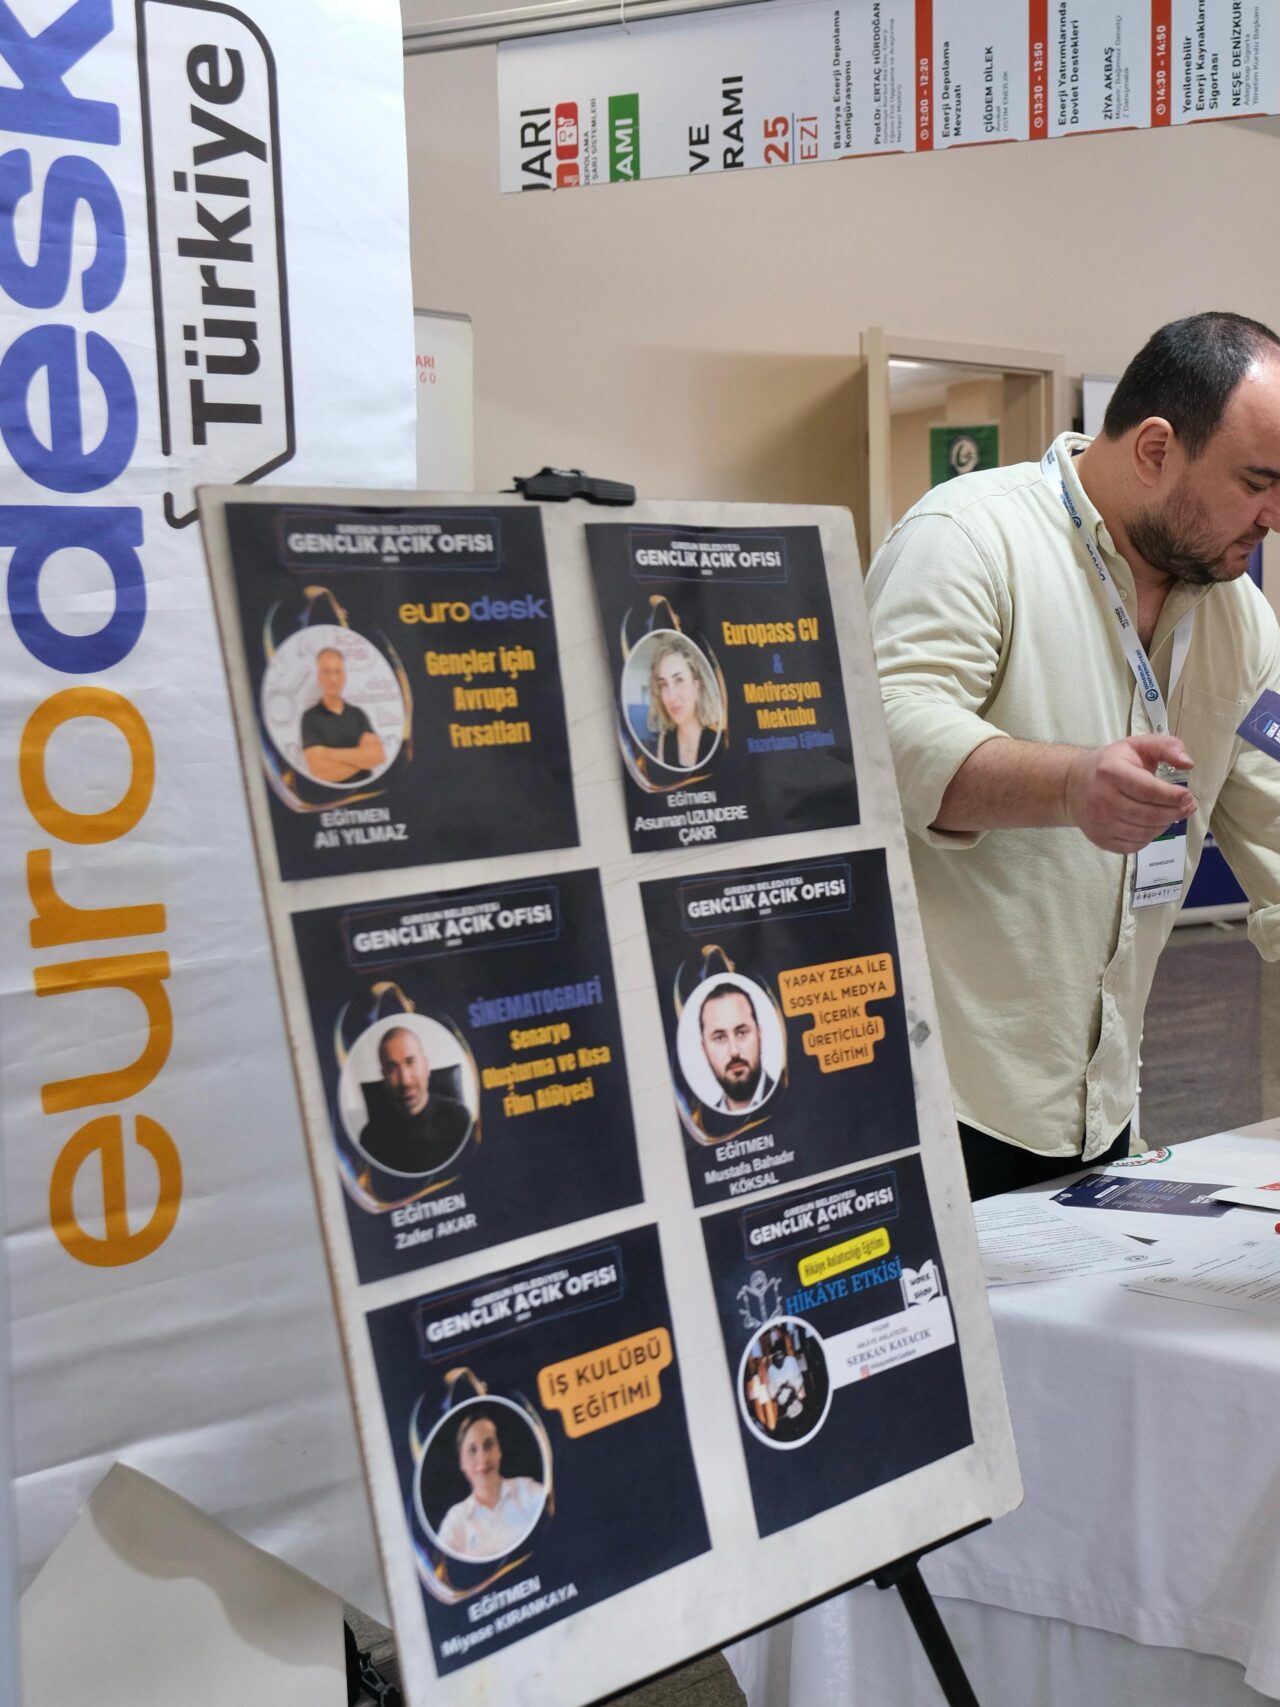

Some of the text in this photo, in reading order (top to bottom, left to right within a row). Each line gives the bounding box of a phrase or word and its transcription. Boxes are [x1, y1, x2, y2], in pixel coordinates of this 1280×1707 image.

[871, 2, 881, 65] HÜRDOĞAN
[1230, 0, 1243, 107] NEŞE DENİZKUR
[832, 10, 842, 149] Batarya Enerji Depolama
[873, 68, 882, 103] ERTAÇ
[1033, 42, 1043, 115] 13:30 13:50
[1057, 2, 1067, 126] Enerji Yatırımlarında
[1070, 20, 1079, 124] Devlet Destekleri
[1102, 47, 1115, 121] ZİYA AKBAŞ
[1156, 25, 1166, 101] 14:30 14:50
[1182, 35, 1192, 113] Yenilenebilir
[1209, 53, 1219, 110] Sigortası
[843, 60, 853, 148] Konfigürasyonu
[918, 58, 929, 127] 12:00 12:20
[941, 41, 950, 138] Enerji Depolama
[953, 84, 961, 137] Mevzuatı
[982, 45, 995, 133] ÇİĞDEM DİLEK
[1196, 74, 1206, 111] Enerji
[721, 75, 744, 170] RAMI
[763, 115, 790, 165] 25
[799, 115, 818, 160] EZİ
[615, 118, 634, 181] AMI
[688, 124, 710, 173] VE
[173, 42, 268, 446] Türkiye
[398, 594, 548, 625] eurodesk
[0, 0, 184, 1268] eurodesk
[721, 617, 820, 648] Europass CV
[424, 646, 536, 682] Gençler için
[772, 653, 784, 674] &
[453, 686, 519, 712] Avrupa
[742, 680, 822, 704] Motivasyon
[449, 720, 532, 749] Fırsatları
[756, 707, 817, 730] Mektubu
[319, 807, 391, 829] EĞİTMEN
[634, 805, 749, 832] Asuman UZUNDERE
[666, 790, 717, 808] EĞİTMEN
[313, 823, 410, 850] Ali YILMAZ
[678, 827, 718, 847] ÇAKIR
[783, 958, 888, 990] YAPAY ZEKA İLE
[789, 980, 887, 1010] SOSYAL MEDYA
[467, 975, 605, 1029] SİNEMATOGRAFİ
[818, 1006, 861, 1027] İÇERİK
[509, 1021, 572, 1052] Senaryo
[807, 1022, 881, 1049] ÜRETİCİLİĞİ
[823, 1043, 869, 1067] EĞİTİMİ
[715, 1133, 775, 1162] EĞİTMEN
[704, 1163, 752, 1186] Mustafa
[729, 1171, 780, 1196] KÖKSAL
[390, 1192, 466, 1228] EĞİTMEN
[394, 1213, 479, 1251] Zafer AKAR
[785, 1256, 903, 1316] HİKÂYE ETKİSİ
[547, 1336, 662, 1398] İŞ KULÜBÜ
[846, 1344, 887, 1368] SERKAN
[887, 1329, 932, 1352] KAYACIK
[572, 1375, 652, 1425] EĞİTİMİ
[440, 1582, 580, 1659] Miyase KIRANKAYA
[467, 1574, 542, 1624] EĞİTMEN
